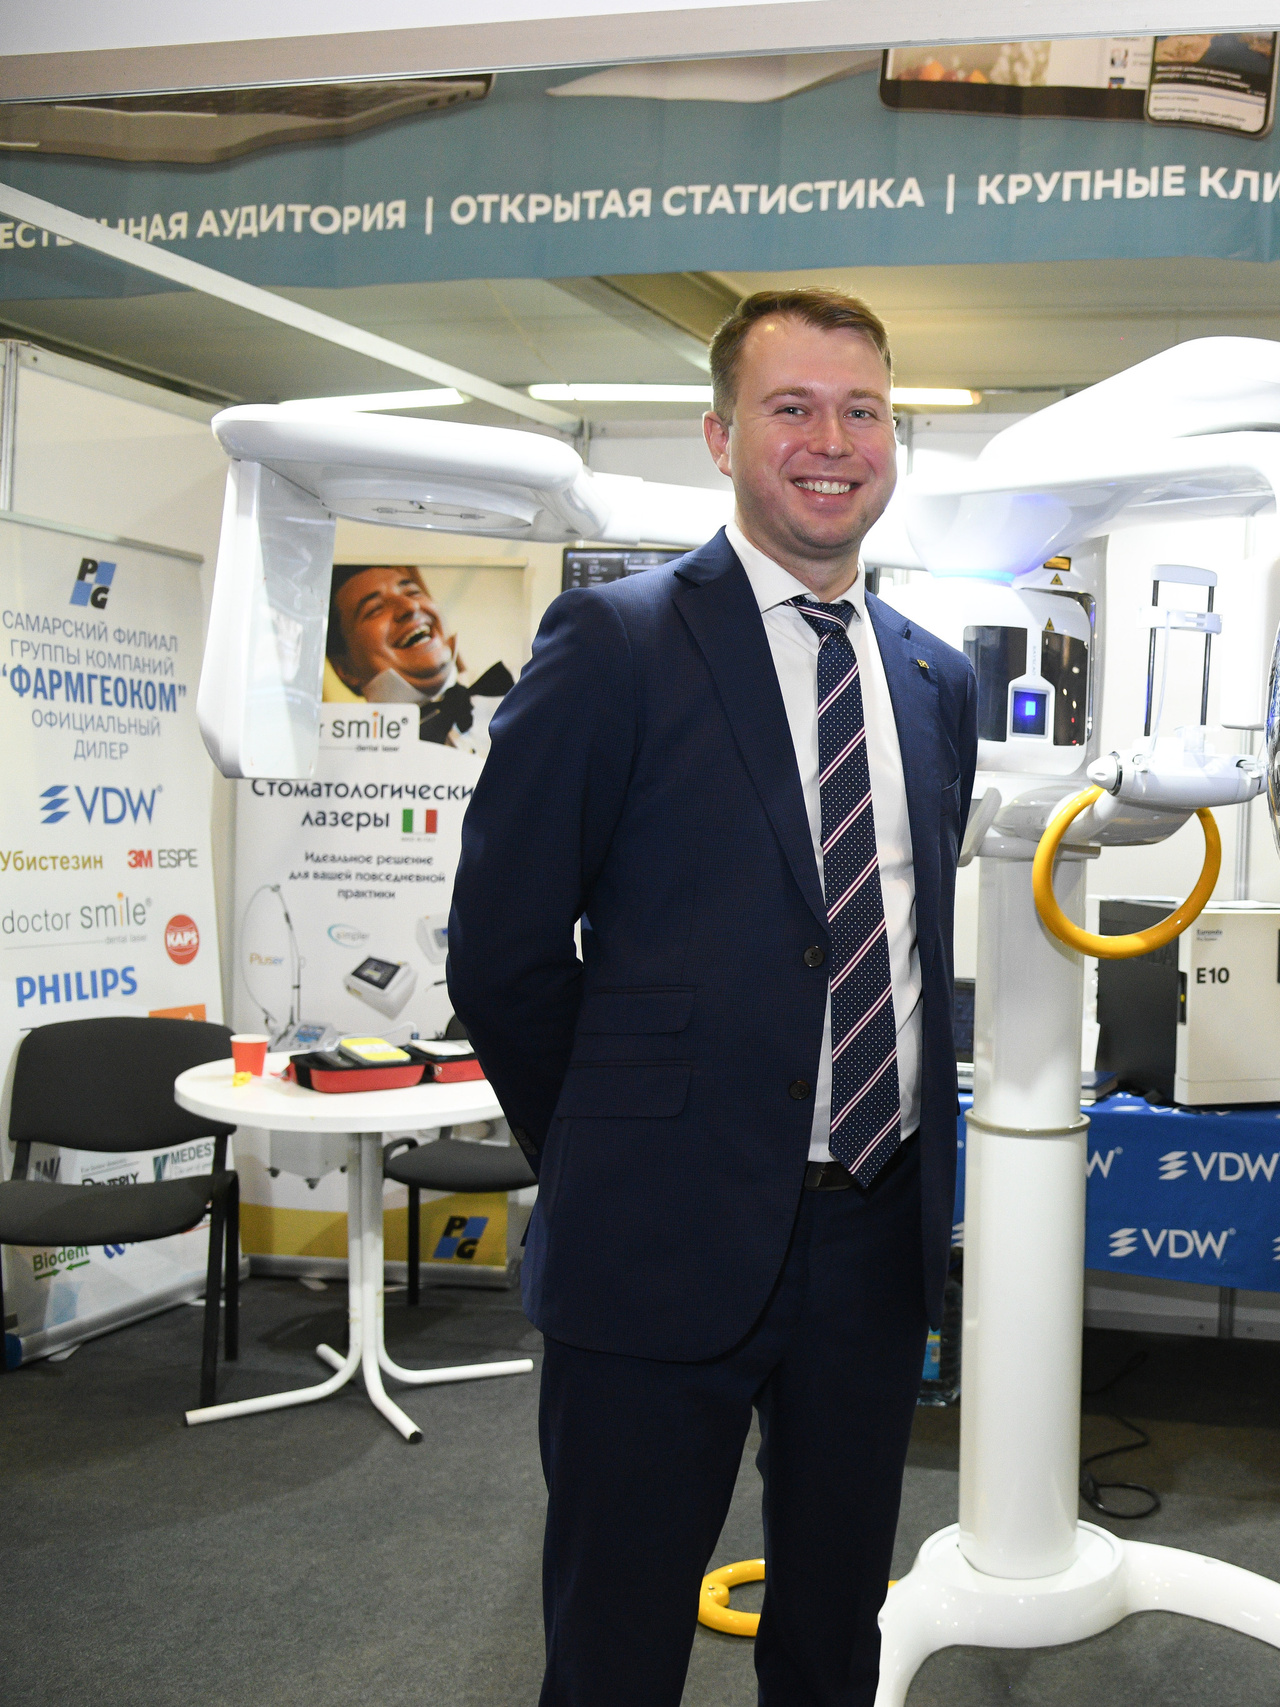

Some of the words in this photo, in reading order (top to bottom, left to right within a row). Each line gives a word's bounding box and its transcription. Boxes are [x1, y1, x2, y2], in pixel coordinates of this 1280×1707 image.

[196, 199, 407, 239] АУДИТОРИЯ
[450, 188, 652, 225] ОТКРЫТАЯ
[662, 177, 926, 216] СТАТИСТИКА
[976, 165, 1187, 205] КРУПНЫЕ
[2, 609, 109, 643] САМАРСКИЙ
[113, 626, 178, 654] ФИЛИАЛ
[10, 638, 81, 666] ГРУППЫ
[86, 650, 175, 678] КОМПАНИЙ
[31, 708, 162, 738] ОФИЦИАЛЬНЫЙ
[73, 739, 129, 761] ДИЛЕР
[301, 810, 389, 832] лазеры
[0, 850, 104, 872] Убистезин
[127, 850, 153, 869] 3M
[158, 849, 199, 869] ESPE
[304, 851, 373, 864] Идеальное
[376, 854, 434, 866] решение
[288, 871, 309, 881] для
[313, 869, 352, 881] вашей
[355, 871, 446, 883] повседневной
[337, 888, 396, 900] практики
[1, 909, 71, 935] doctor
[165, 931, 199, 948] KAPS
[1196, 967, 1230, 984] E10
[15, 966, 138, 1008] PHILIPS
[169, 1142, 214, 1165] MEDES
[1191, 1151, 1280, 1182] VDW
[1141, 1228, 1229, 1260] VDW
